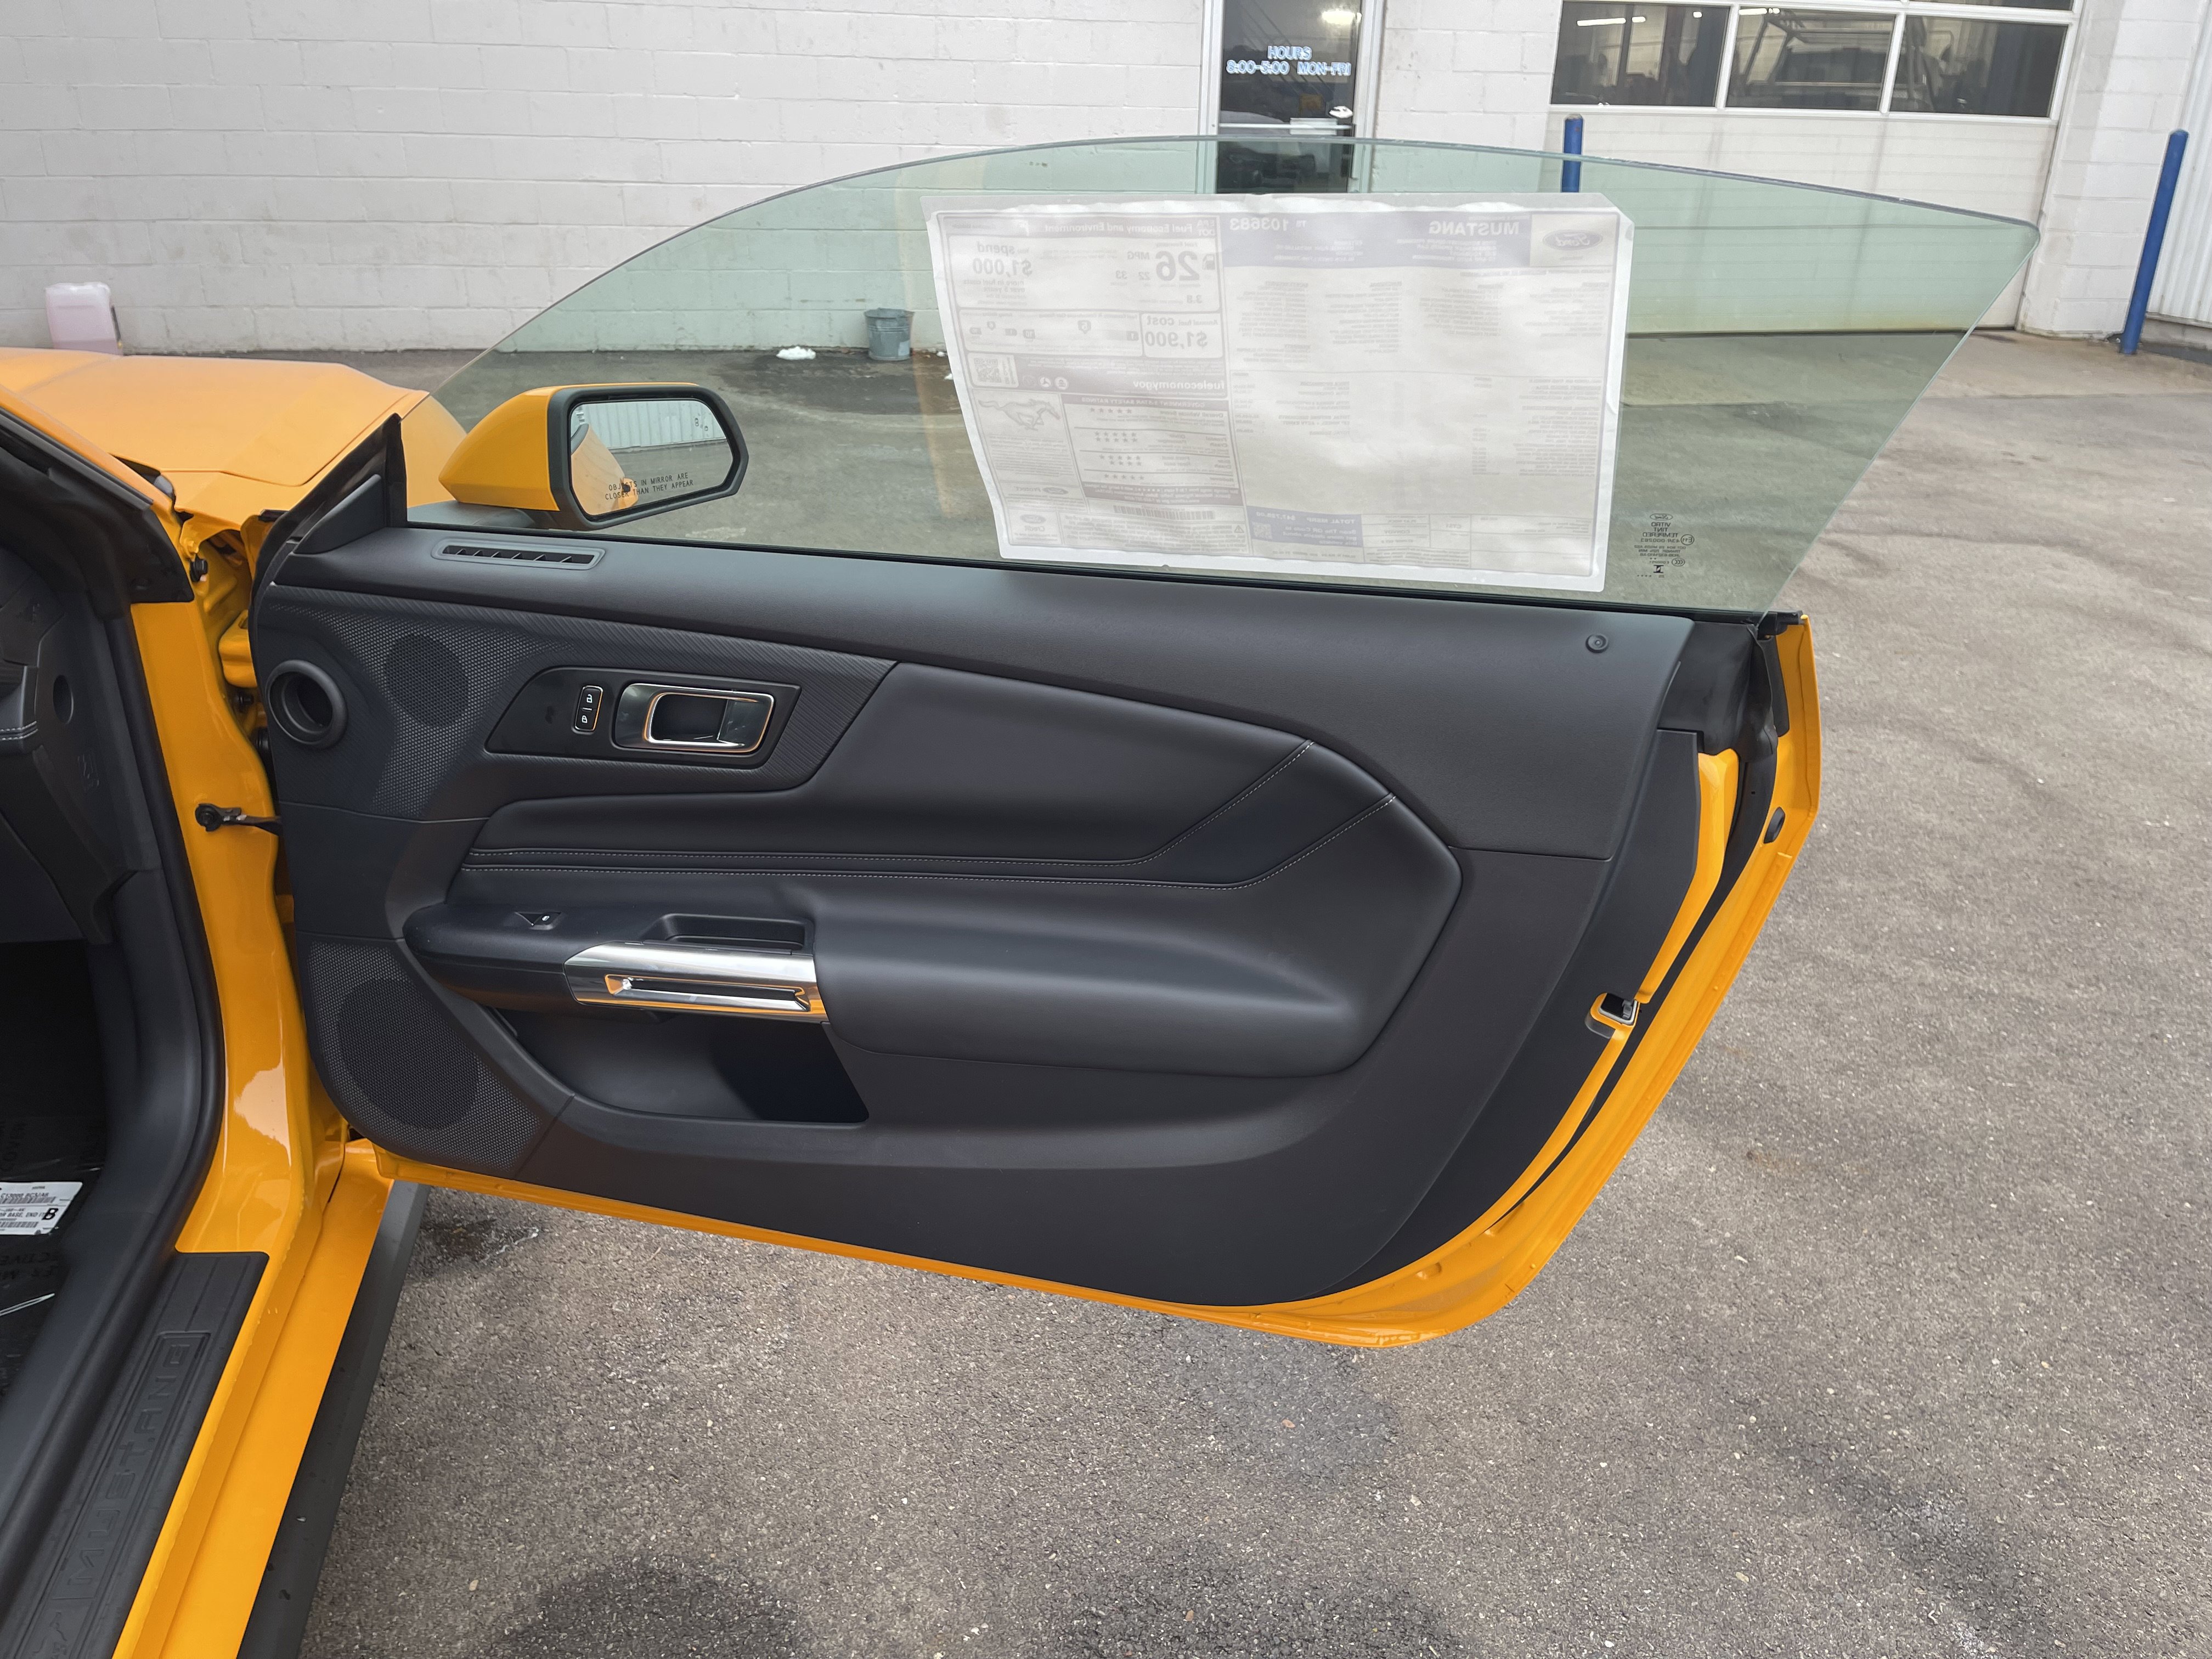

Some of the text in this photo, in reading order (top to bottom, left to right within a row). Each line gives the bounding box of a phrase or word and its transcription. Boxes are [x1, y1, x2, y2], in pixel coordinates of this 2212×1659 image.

[1267, 46, 1312, 60] HOURS
[1226, 60, 1351, 76] 8:00-5:00 MON-FRI
[609, 481, 637, 491] OBJTS
[651, 476, 673, 484] MIRROR
[633, 487, 649, 496] THAN
[653, 484, 667, 492] THEY
[671, 479, 694, 489] APPEAR
[42, 1207, 59, 1220] B
